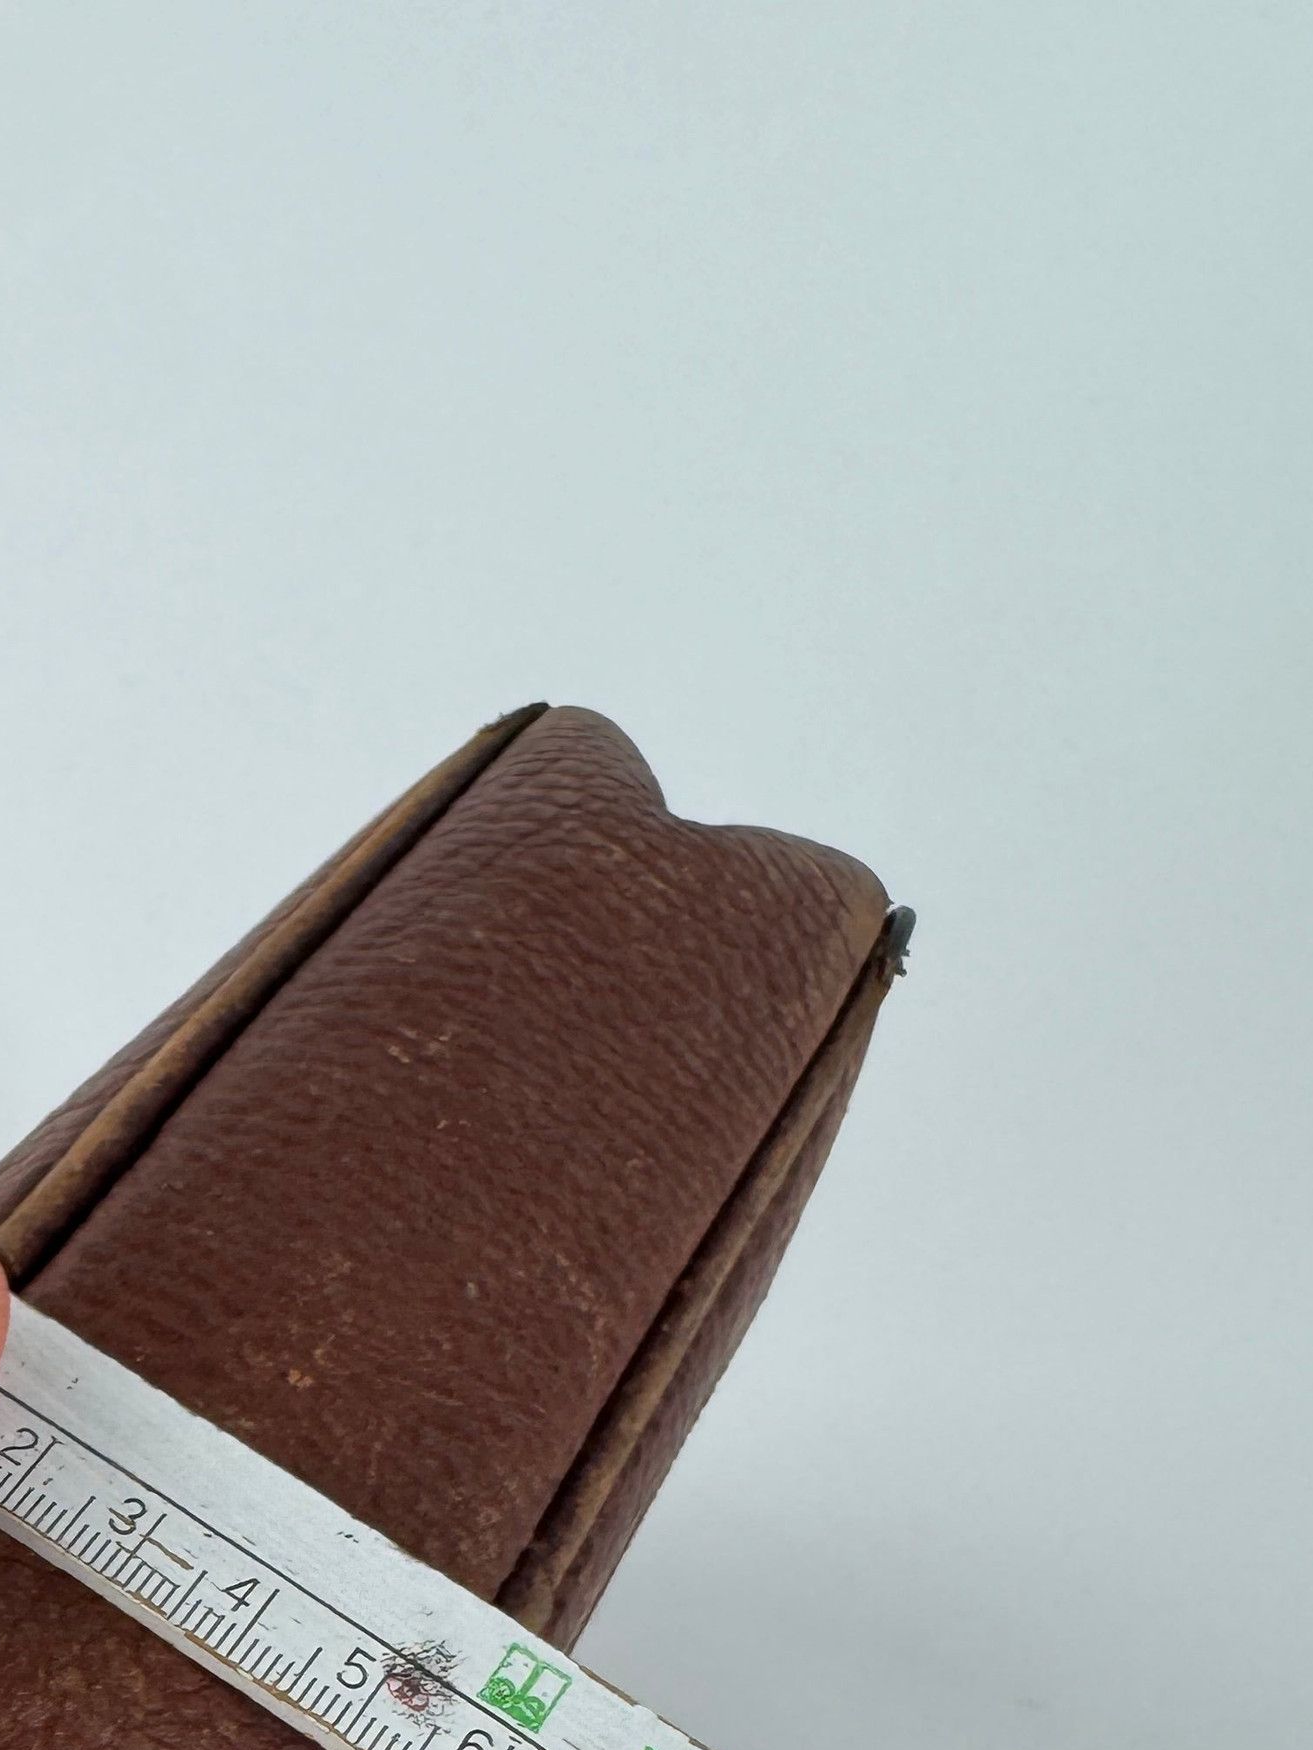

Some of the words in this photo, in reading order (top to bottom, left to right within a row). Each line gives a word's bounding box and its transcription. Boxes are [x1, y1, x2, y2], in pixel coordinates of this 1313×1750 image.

[107, 1497, 147, 1537] 3
[222, 1578, 261, 1612] 4
[335, 1646, 377, 1690] 5
